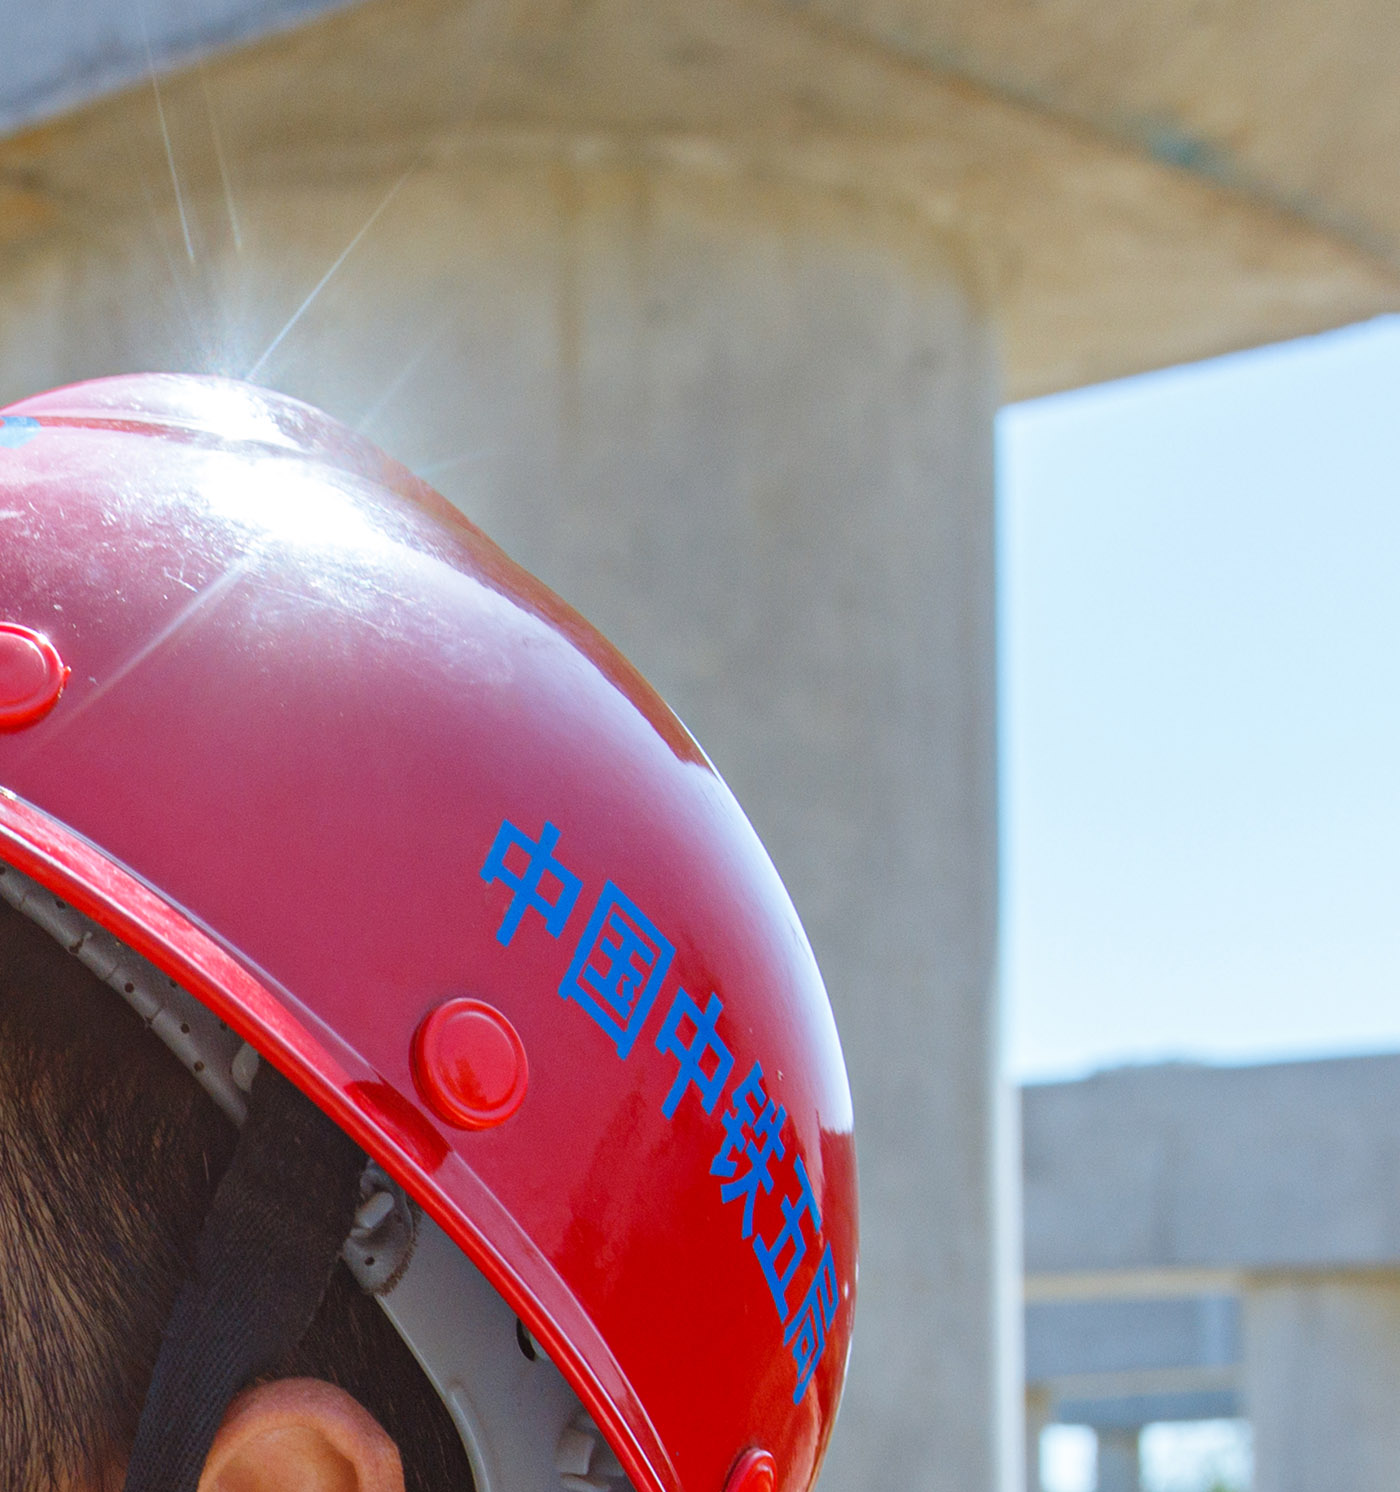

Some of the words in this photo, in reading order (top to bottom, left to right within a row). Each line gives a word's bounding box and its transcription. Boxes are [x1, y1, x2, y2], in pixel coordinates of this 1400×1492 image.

[479, 818, 839, 1406] 中国中铁五局
